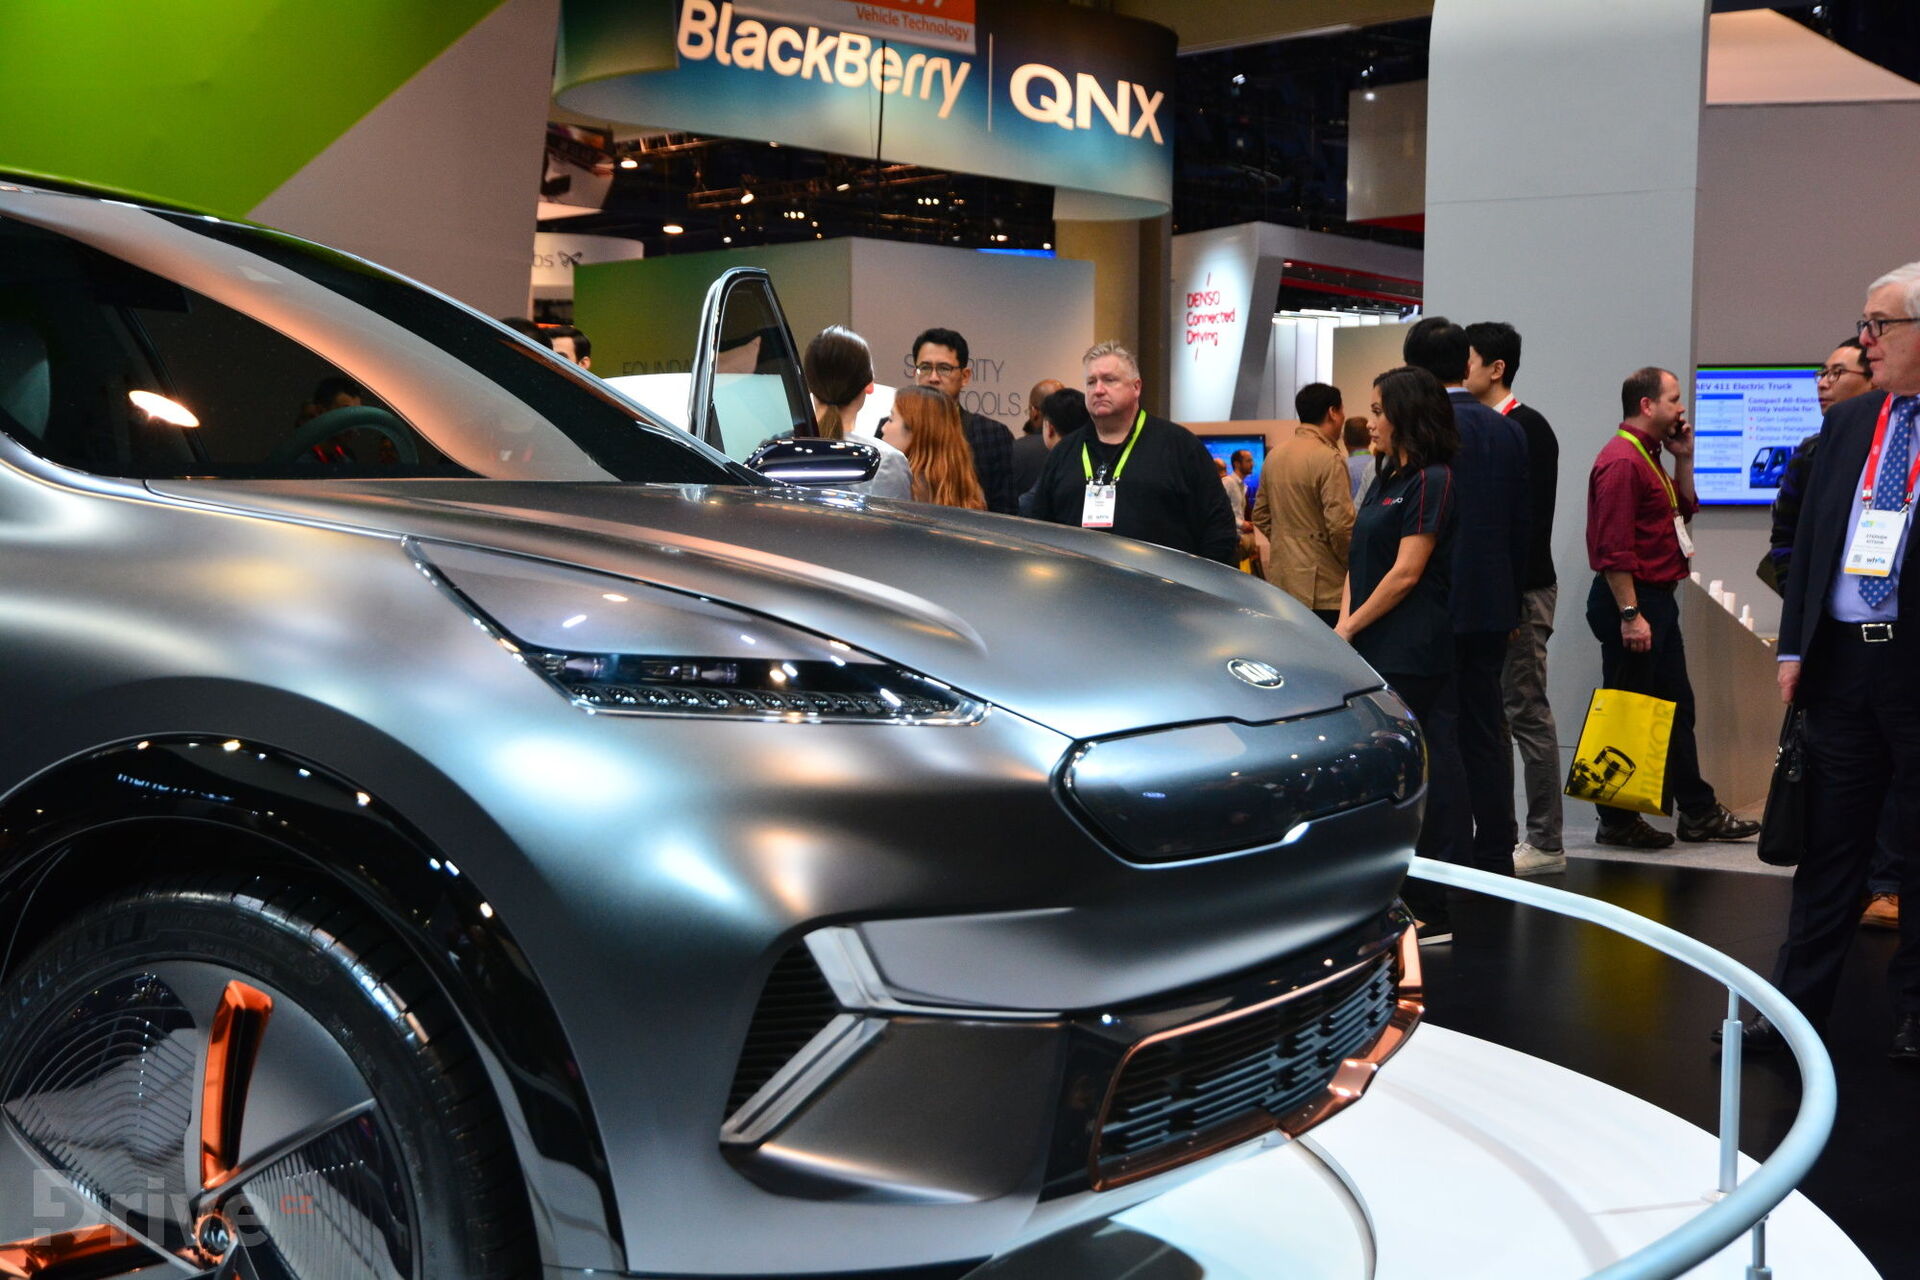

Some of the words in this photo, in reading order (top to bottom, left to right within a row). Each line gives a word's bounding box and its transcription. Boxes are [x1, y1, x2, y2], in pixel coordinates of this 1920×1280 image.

[855, 5, 899, 26] Vehicle
[901, 14, 969, 42] Technology
[677, 0, 972, 119] BlackBerry
[1009, 63, 1165, 145] QNX
[1186, 291, 1220, 308] DENSO
[1186, 308, 1235, 327] Connected
[1186, 330, 1218, 346] Driving
[1733, 382, 1764, 390] Electric
[1768, 382, 1792, 390] Truck
